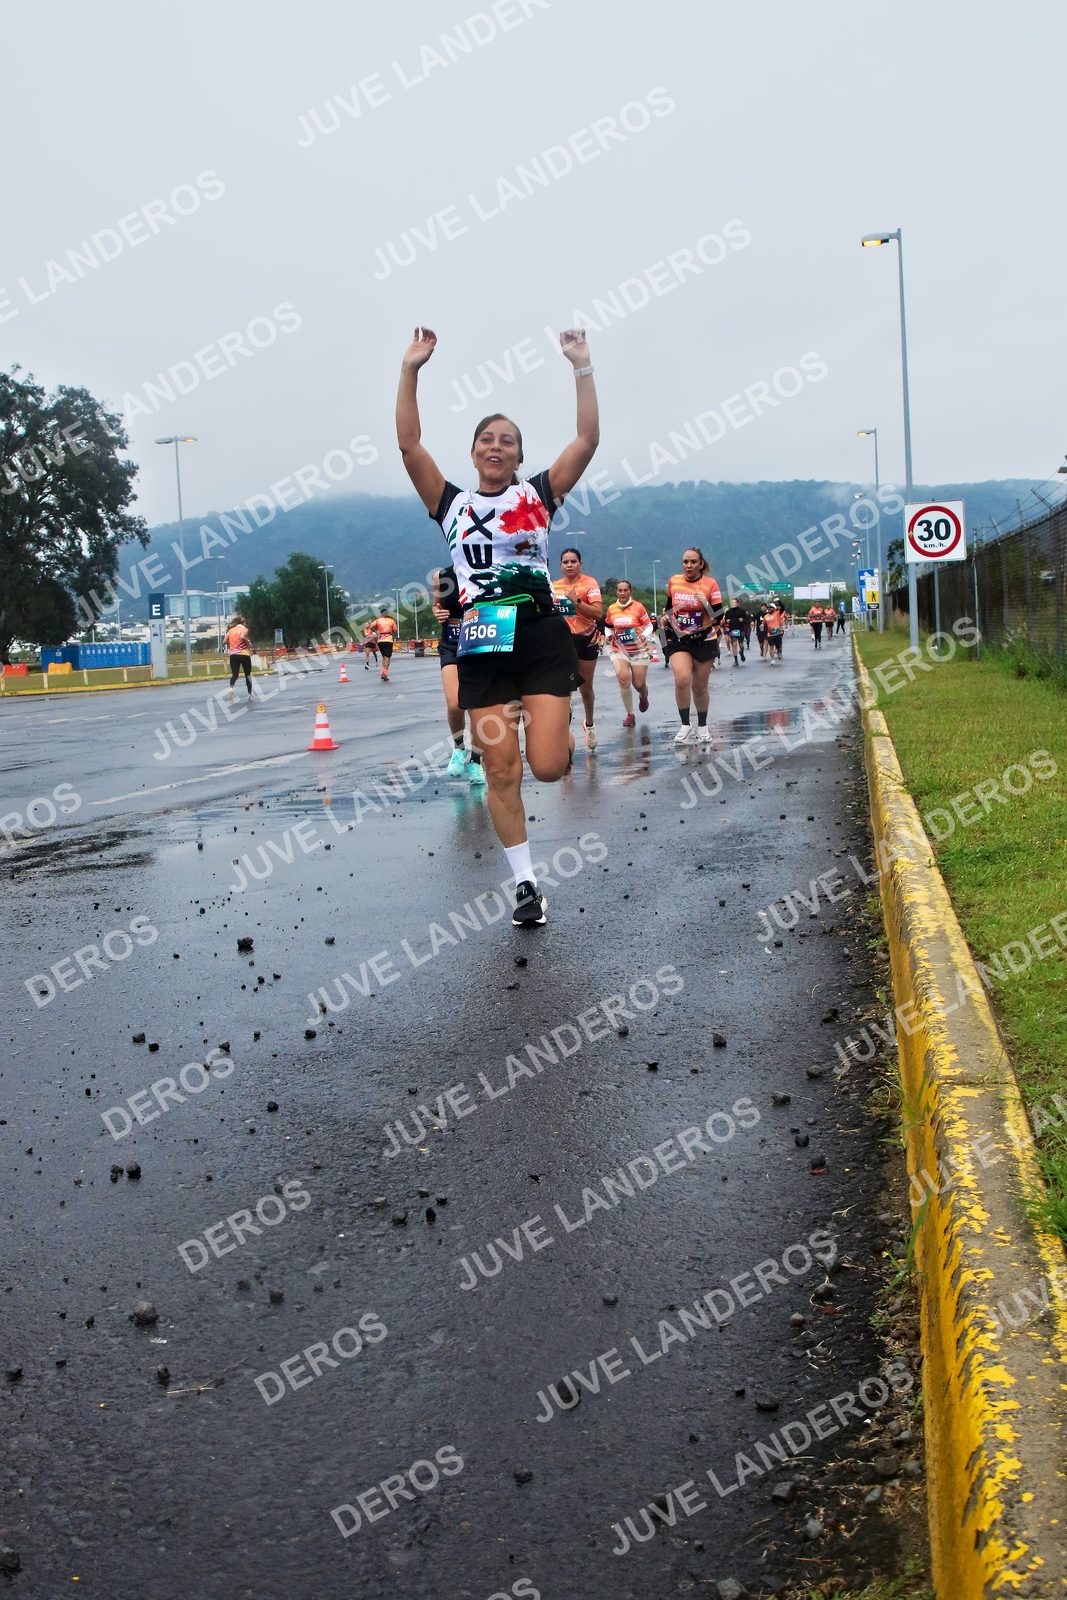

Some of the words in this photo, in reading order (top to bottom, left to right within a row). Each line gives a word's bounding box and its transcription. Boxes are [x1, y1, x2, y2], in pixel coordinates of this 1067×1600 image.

[917, 518, 950, 542] 30
[152, 604, 161, 616] E
[464, 624, 497, 641] 1506
